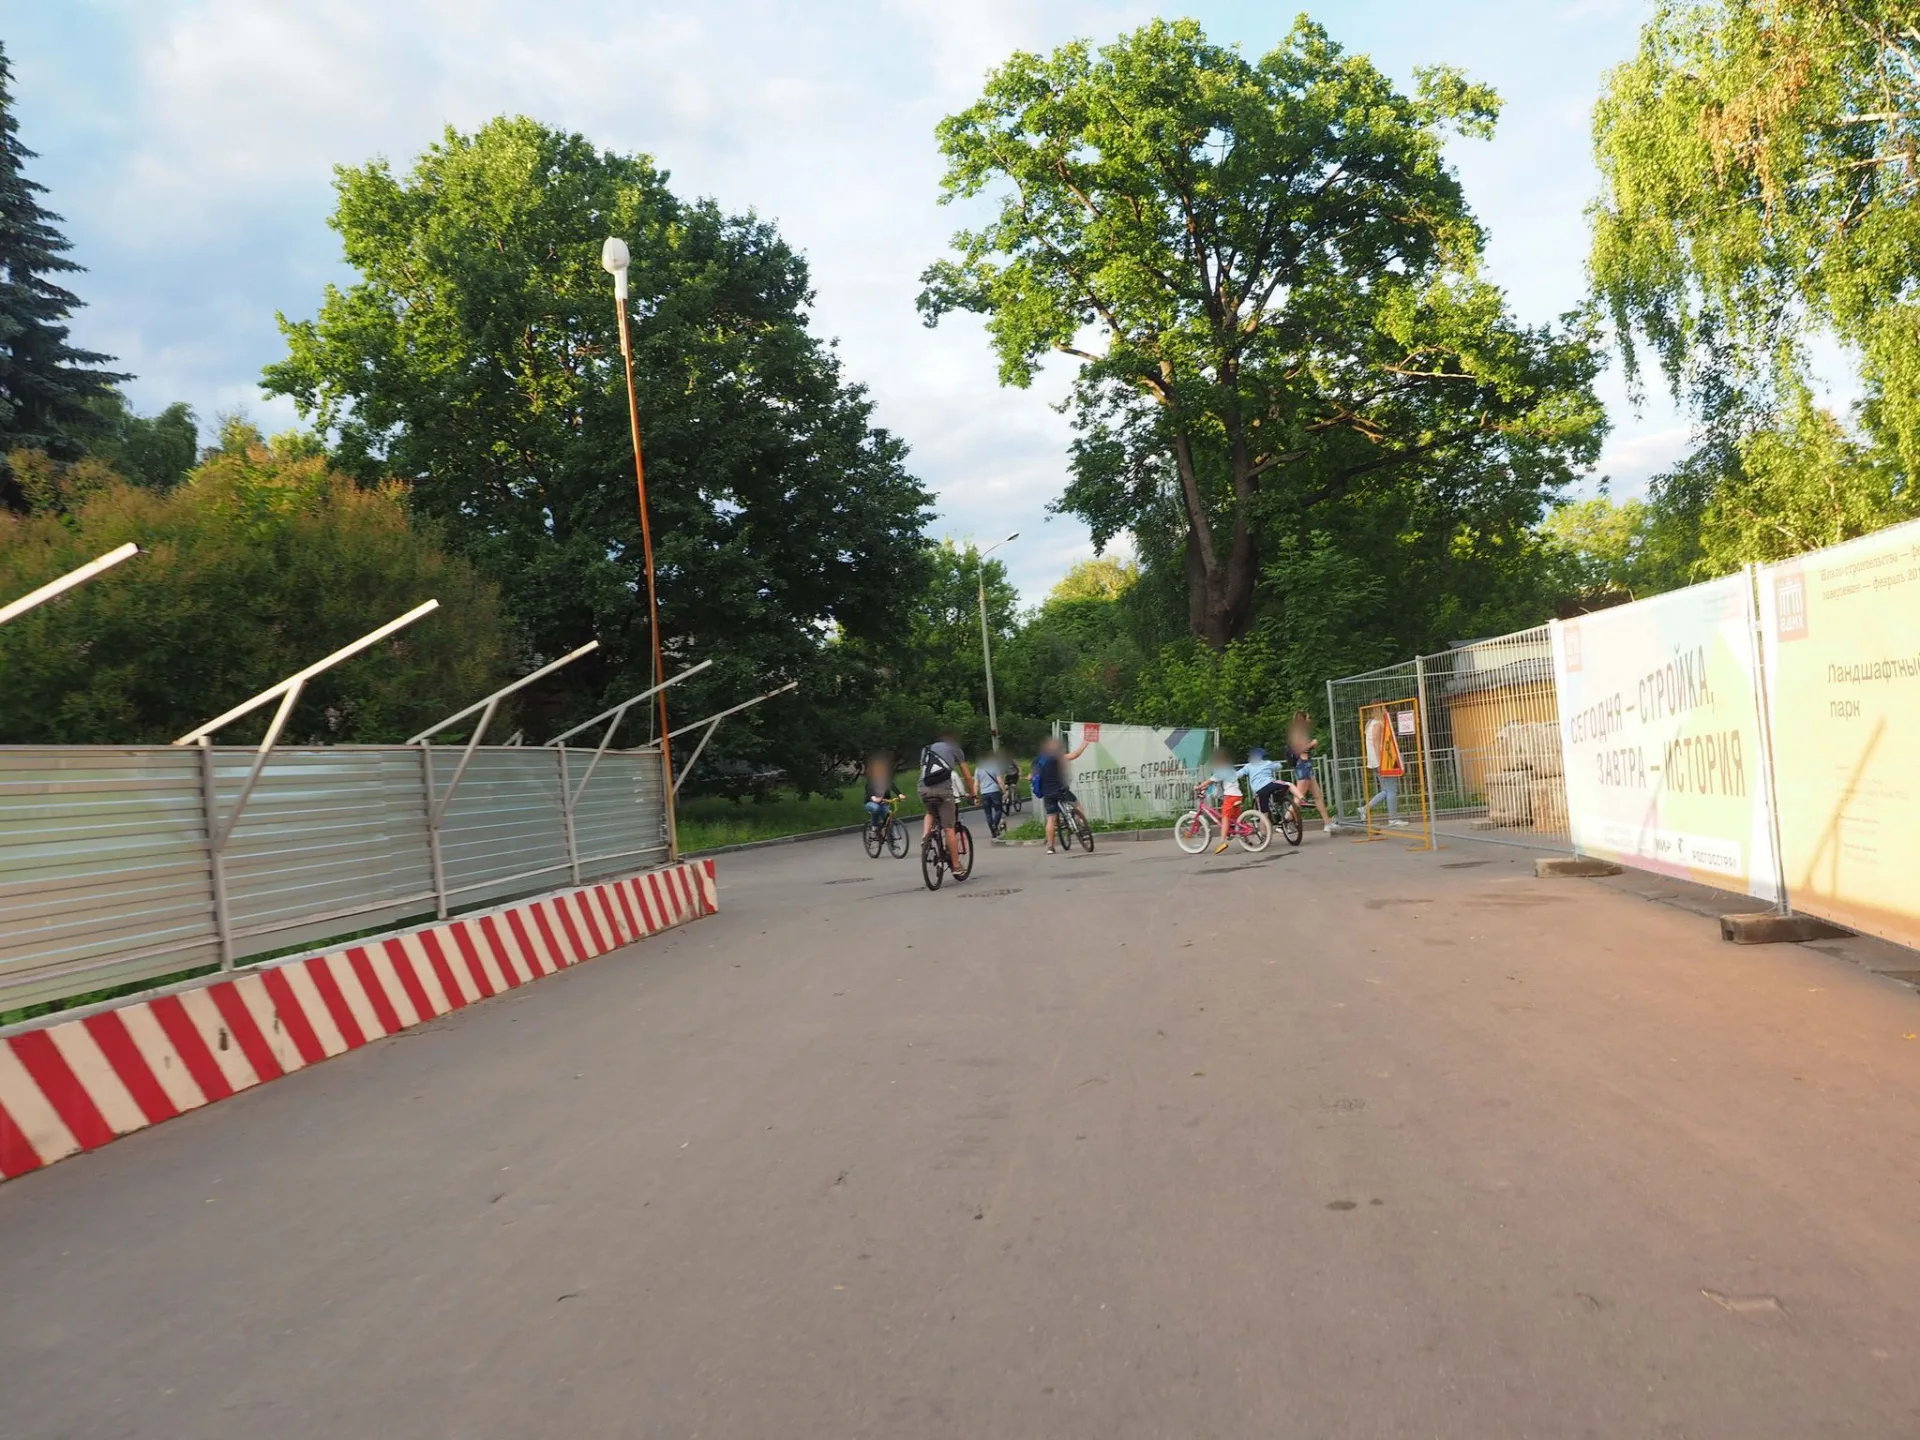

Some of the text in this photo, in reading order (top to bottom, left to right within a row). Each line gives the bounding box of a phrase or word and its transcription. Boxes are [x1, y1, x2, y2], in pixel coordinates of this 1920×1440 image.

[1570, 692, 1623, 745] СЕГОДНЯ
[1638, 642, 1715, 725] СТРОЙКА,
[1830, 700, 1861, 720] парк
[1078, 766, 1126, 784] СЕГОДНЯ
[1596, 745, 1647, 789] ЗАВТРА
[1663, 729, 1746, 797] ИСТОРИЯ
